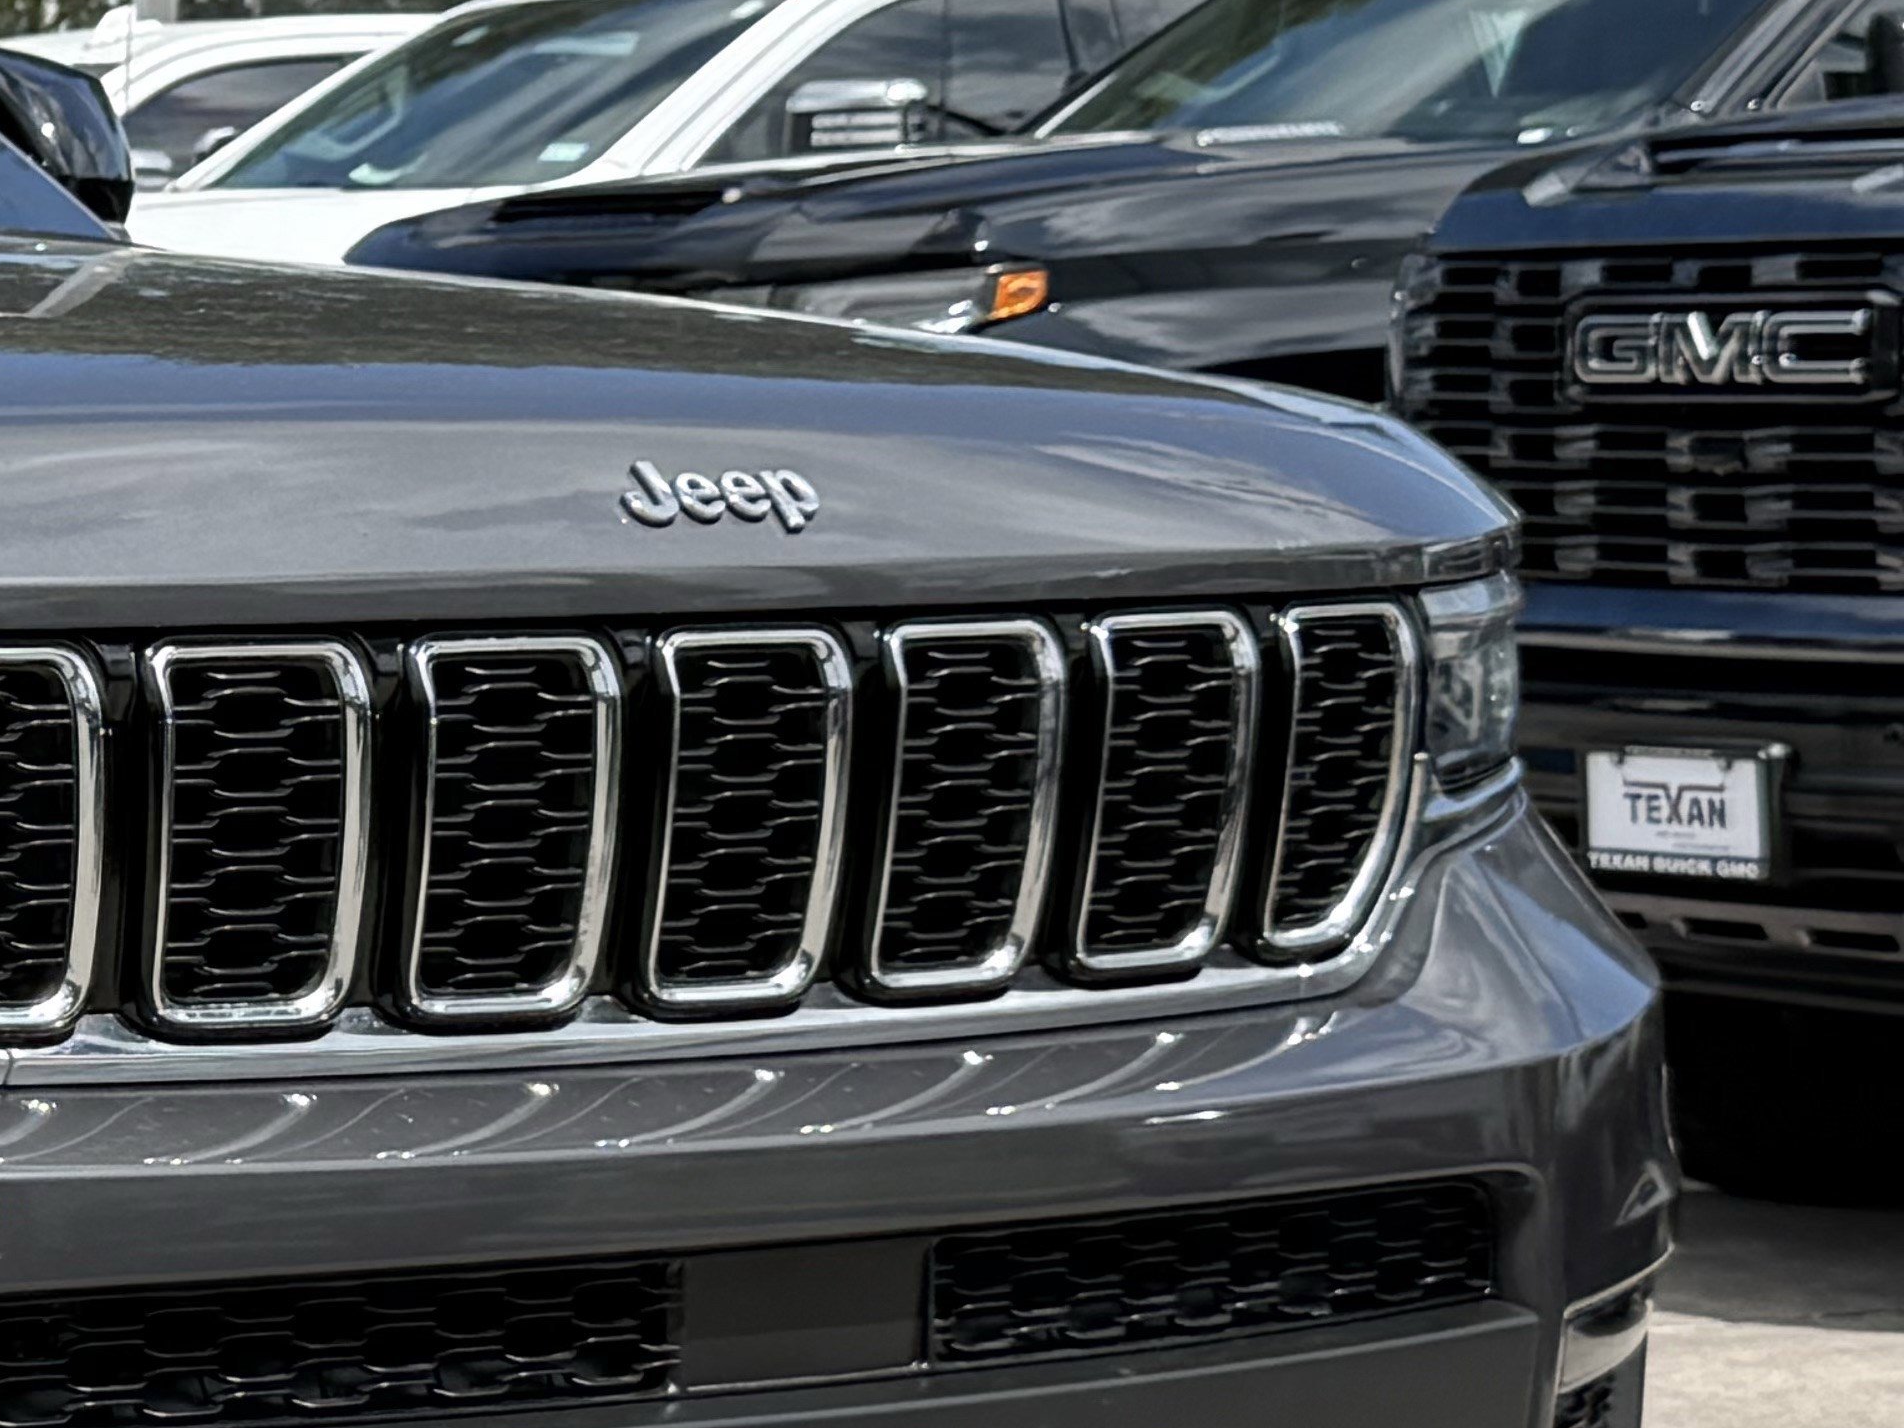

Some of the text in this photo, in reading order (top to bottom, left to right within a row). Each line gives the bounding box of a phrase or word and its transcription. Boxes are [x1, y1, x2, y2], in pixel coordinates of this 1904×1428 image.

[1574, 309, 1871, 385] GMC
[620, 459, 820, 534] Jeep
[1623, 782, 1727, 829] TEXAN
